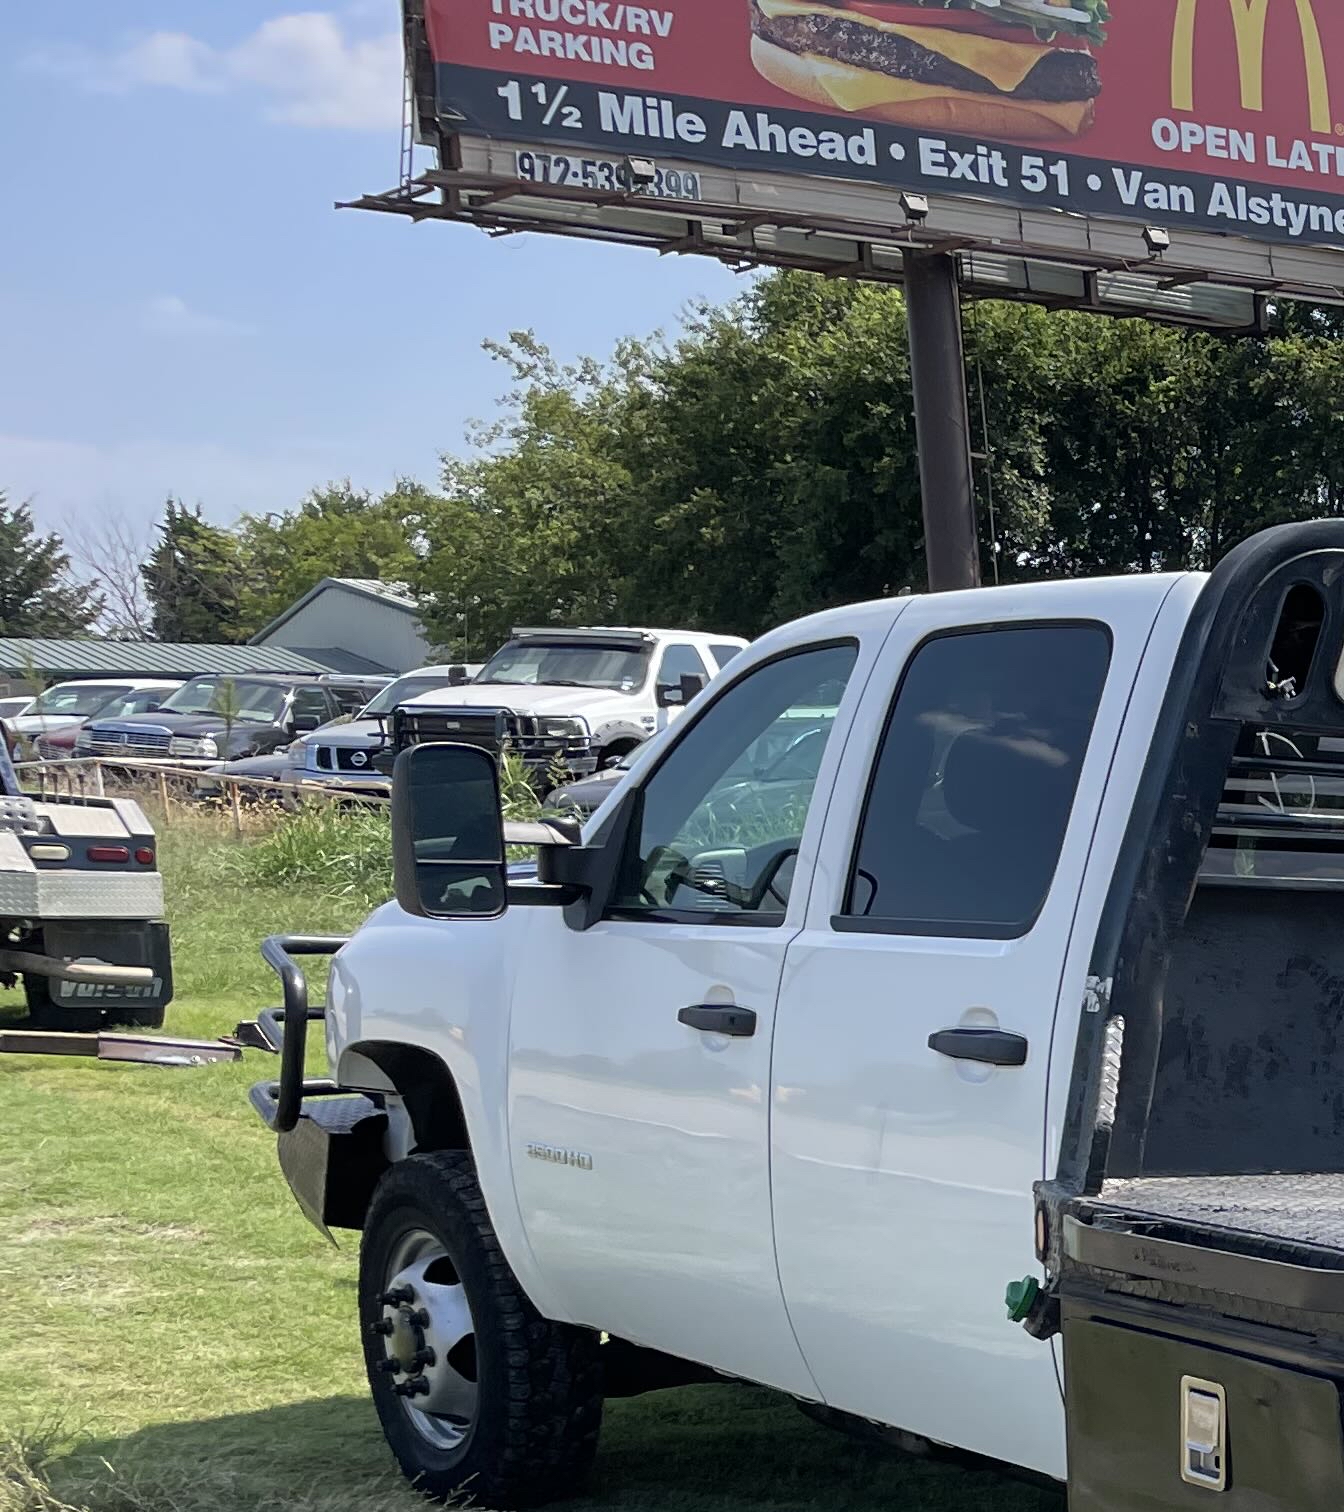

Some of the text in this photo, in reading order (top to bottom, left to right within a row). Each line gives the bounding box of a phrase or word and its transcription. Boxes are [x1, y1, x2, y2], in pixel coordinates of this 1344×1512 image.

[488, 22, 655, 71] PARKING
[598, 91, 707, 143] Mile
[721, 109, 876, 167] Ahead
[917, 136, 1009, 188] Exit
[1020, 154, 1070, 197] 51
[1111, 166, 1196, 214] Van
[1151, 117, 1256, 164] OPEN
